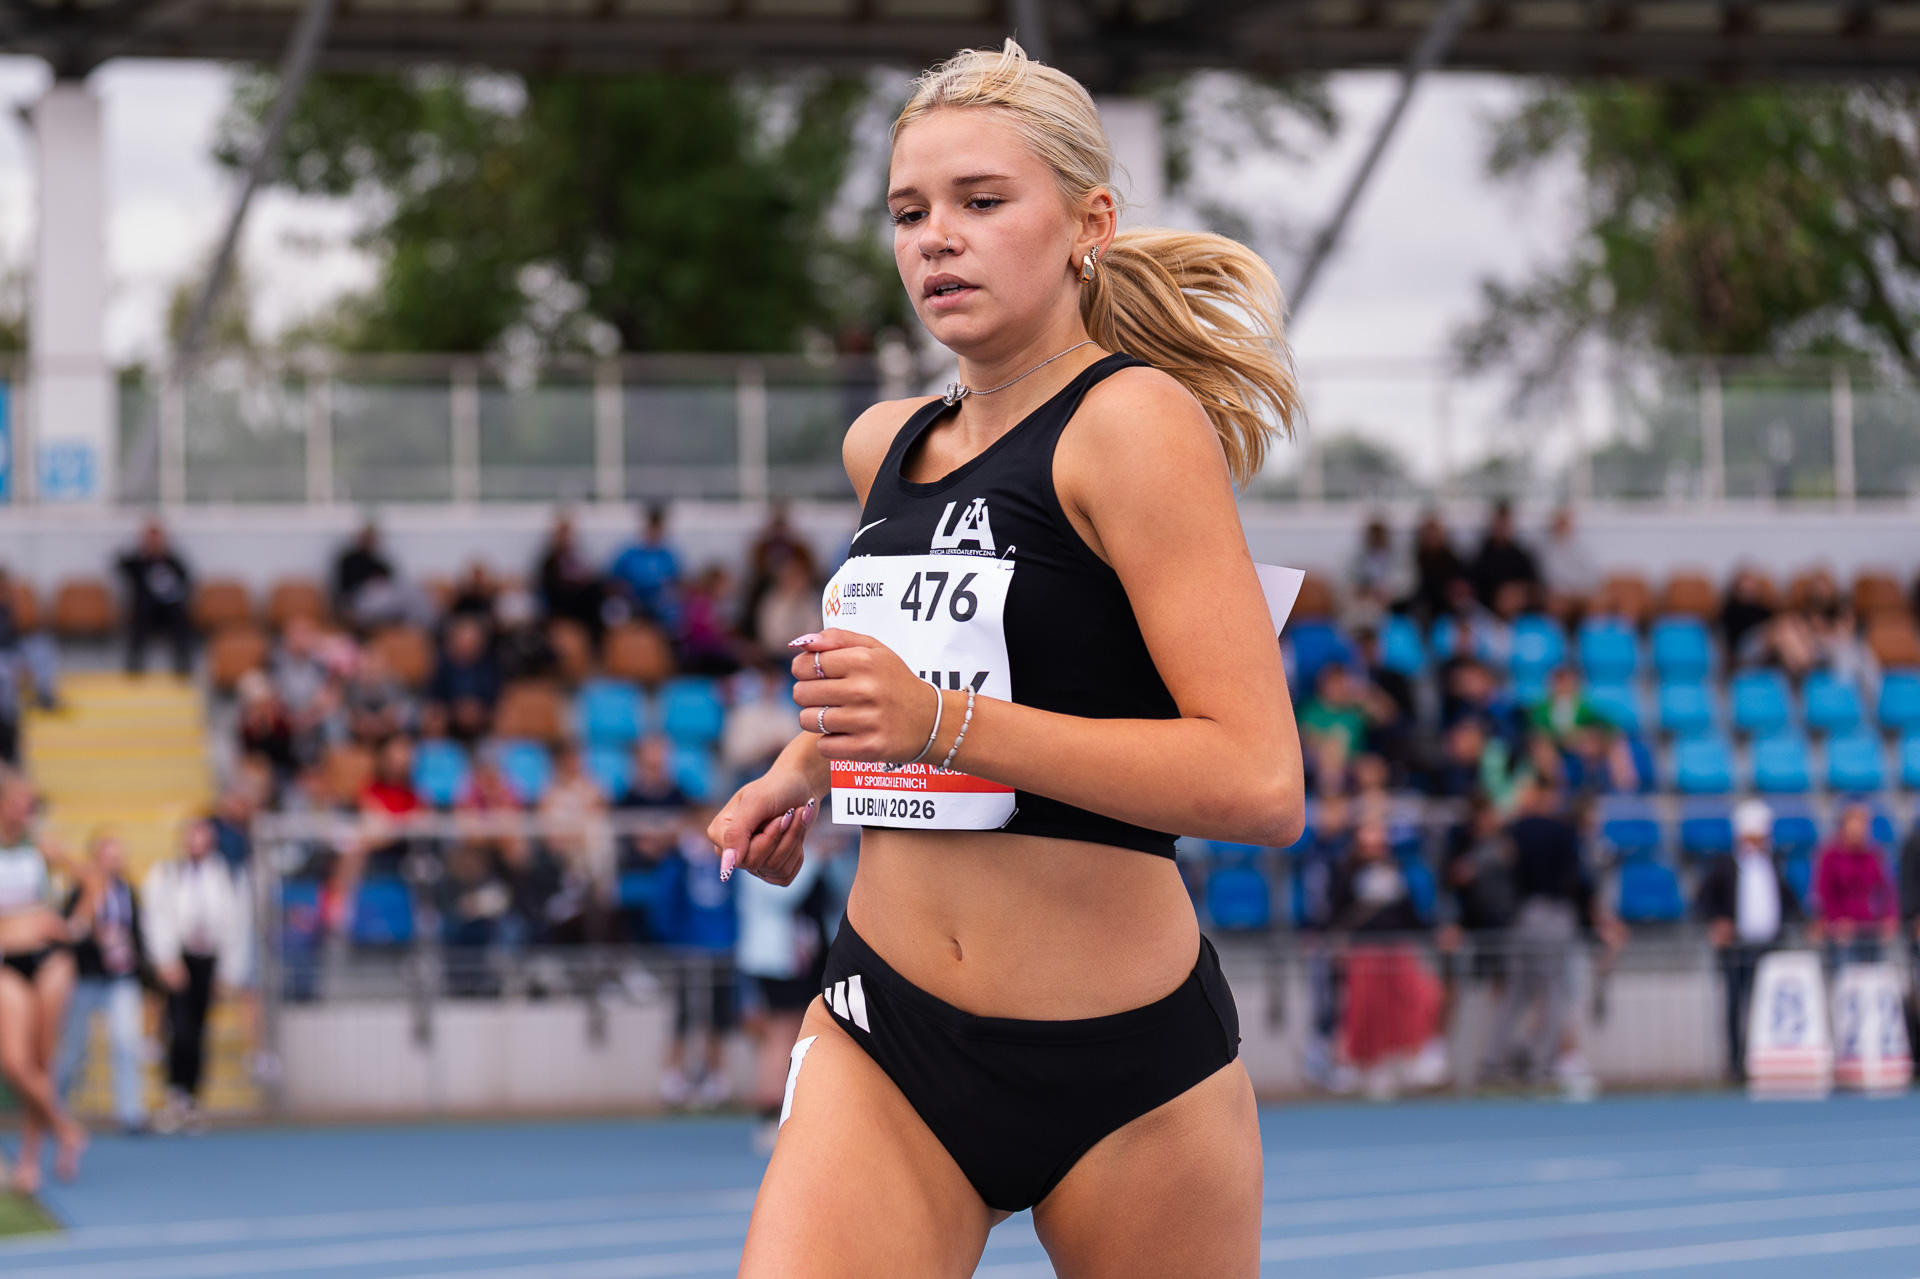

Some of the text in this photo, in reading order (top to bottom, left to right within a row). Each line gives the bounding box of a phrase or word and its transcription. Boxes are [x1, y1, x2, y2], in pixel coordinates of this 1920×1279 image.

[946, 548, 996, 557] LEKKOATLETYCZNA
[843, 582, 884, 598] LUBELSKIE
[900, 571, 979, 622] 476
[842, 602, 857, 615] 2026
[835, 759, 888, 773] OGÓLNOPOLS
[854, 775, 927, 789] W SPORTACH LETNICH
[847, 797, 936, 820] LUBLIN 2026
